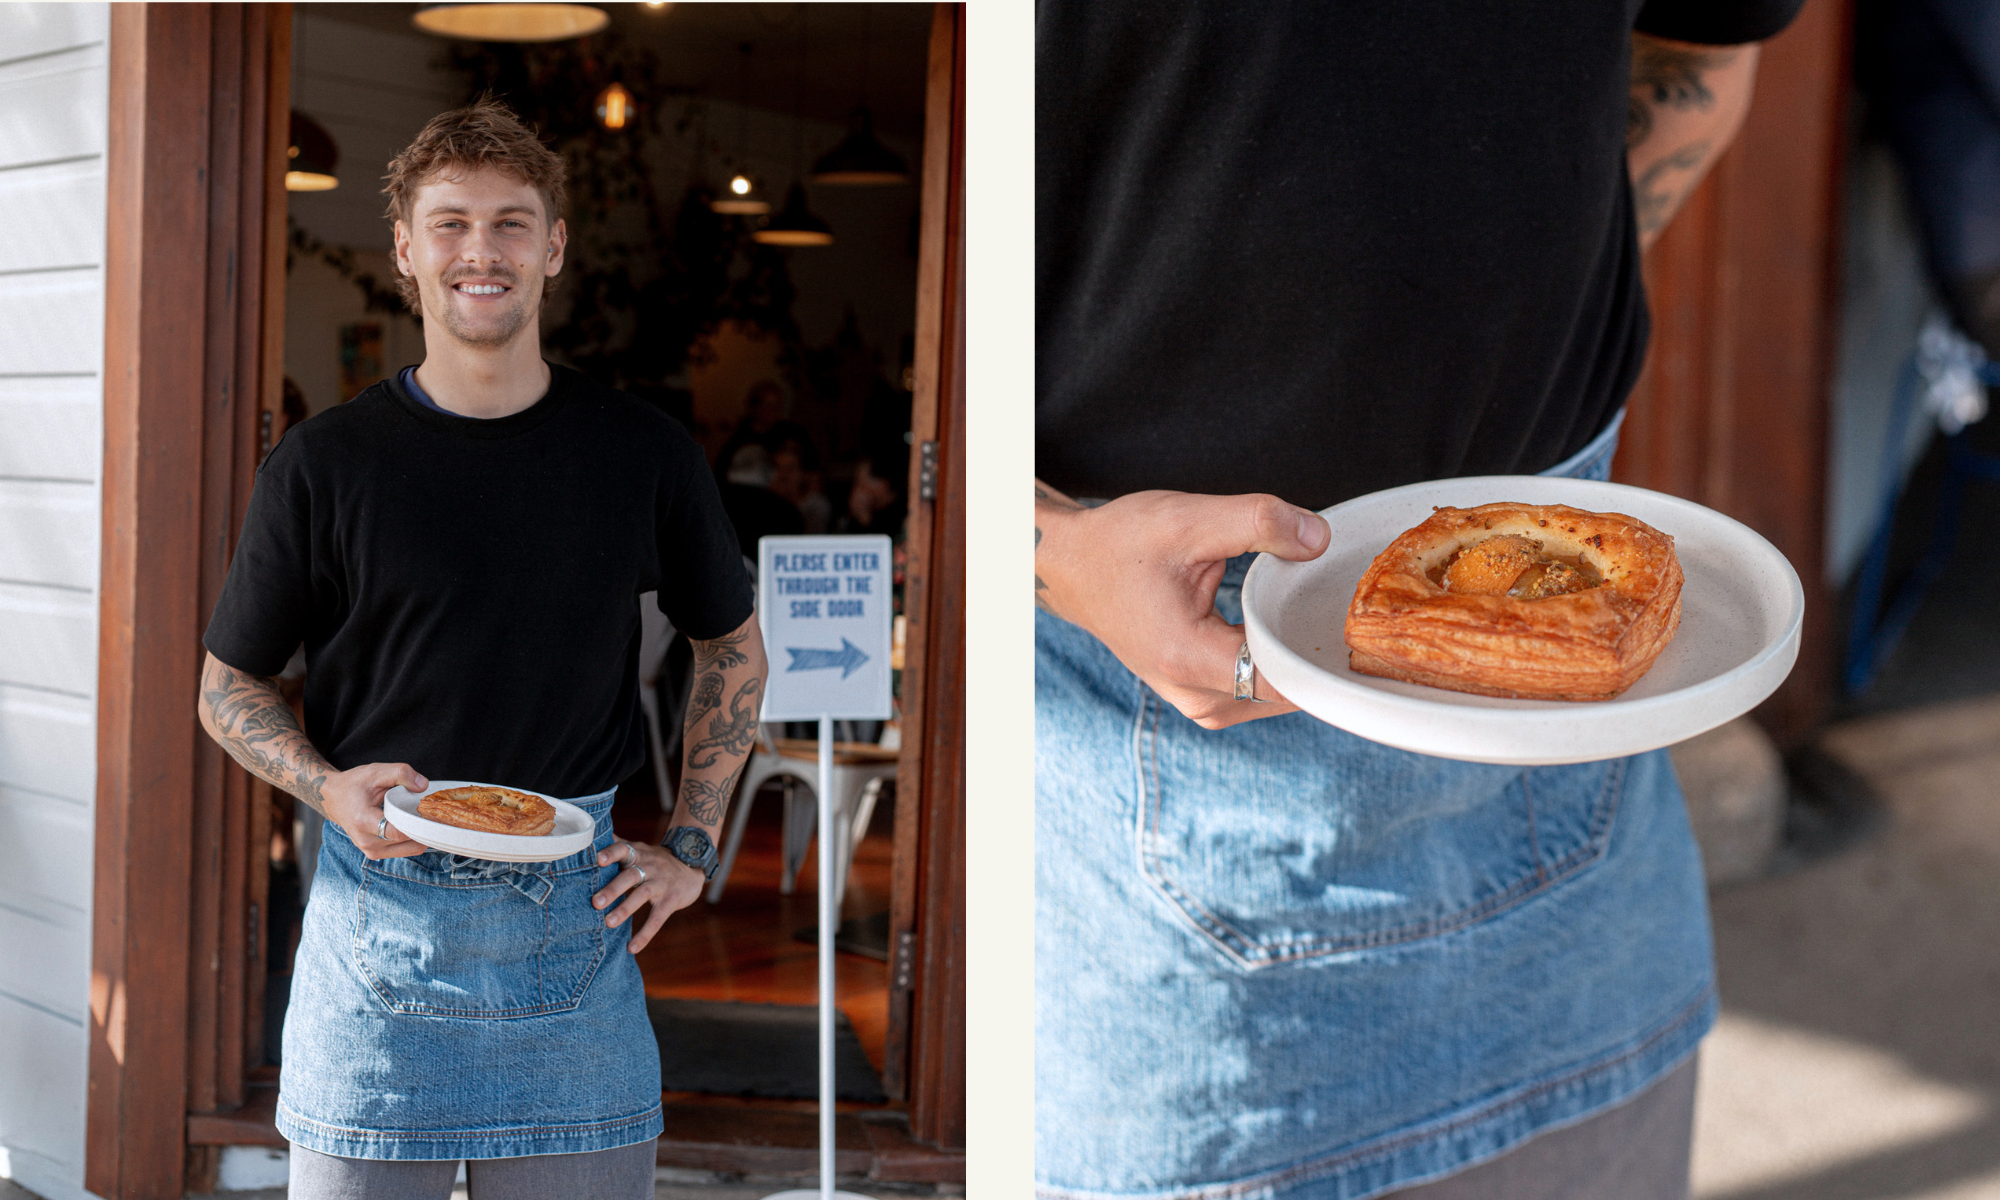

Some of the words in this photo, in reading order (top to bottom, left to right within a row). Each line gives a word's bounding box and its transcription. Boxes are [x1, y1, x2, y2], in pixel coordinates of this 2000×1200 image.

[774, 553, 827, 572] PLEASE
[833, 553, 879, 571] ENTER
[777, 577, 840, 595] THROUGH
[846, 576, 872, 594] THE
[790, 600, 821, 618] SIDE
[828, 599, 864, 618] DOOR
